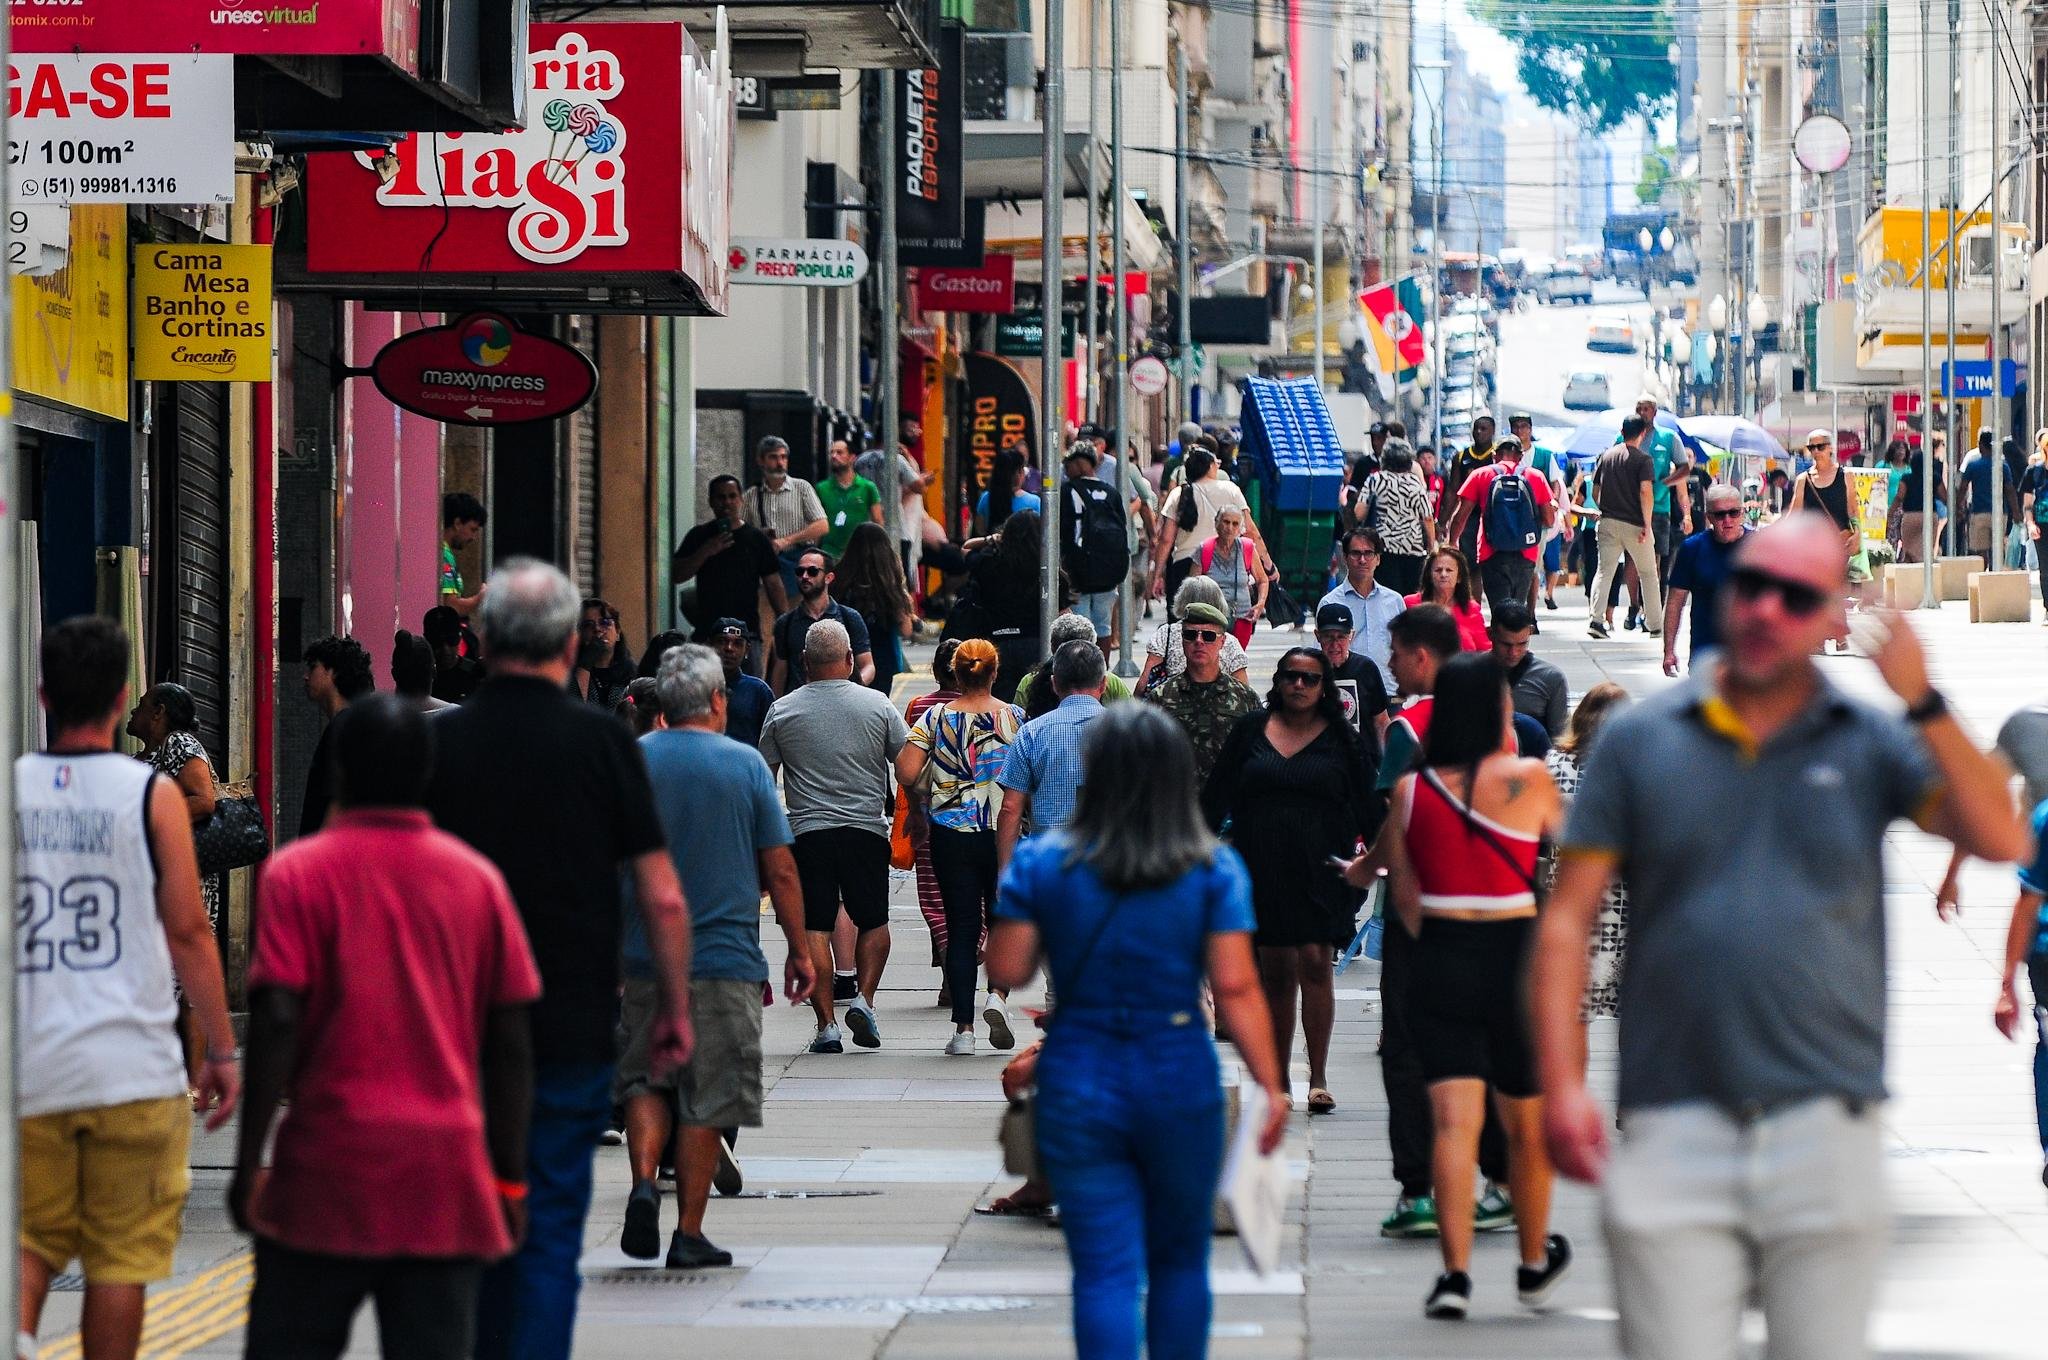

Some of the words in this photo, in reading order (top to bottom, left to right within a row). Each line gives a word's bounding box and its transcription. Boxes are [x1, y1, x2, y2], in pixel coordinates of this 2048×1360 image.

[923, 70, 939, 199] ESPORTES
[40, 139, 134, 164] 100m²
[43, 177, 75, 197] (51)
[80, 177, 176, 194] 99981.1316
[518, 158, 619, 254] Si
[154, 251, 222, 270] Cama
[755, 246, 854, 261] FARMÁCIA
[183, 273, 249, 293] Mesa
[930, 273, 1002, 293] Gaston
[147, 296, 226, 316] Banho
[235, 300, 249, 316] e
[162, 317, 265, 338] Cortinas
[171, 345, 237, 363] Encanto
[423, 369, 545, 392] maxxynpress
[1965, 375, 1993, 391] TIM
[17, 875, 120, 972] 23
